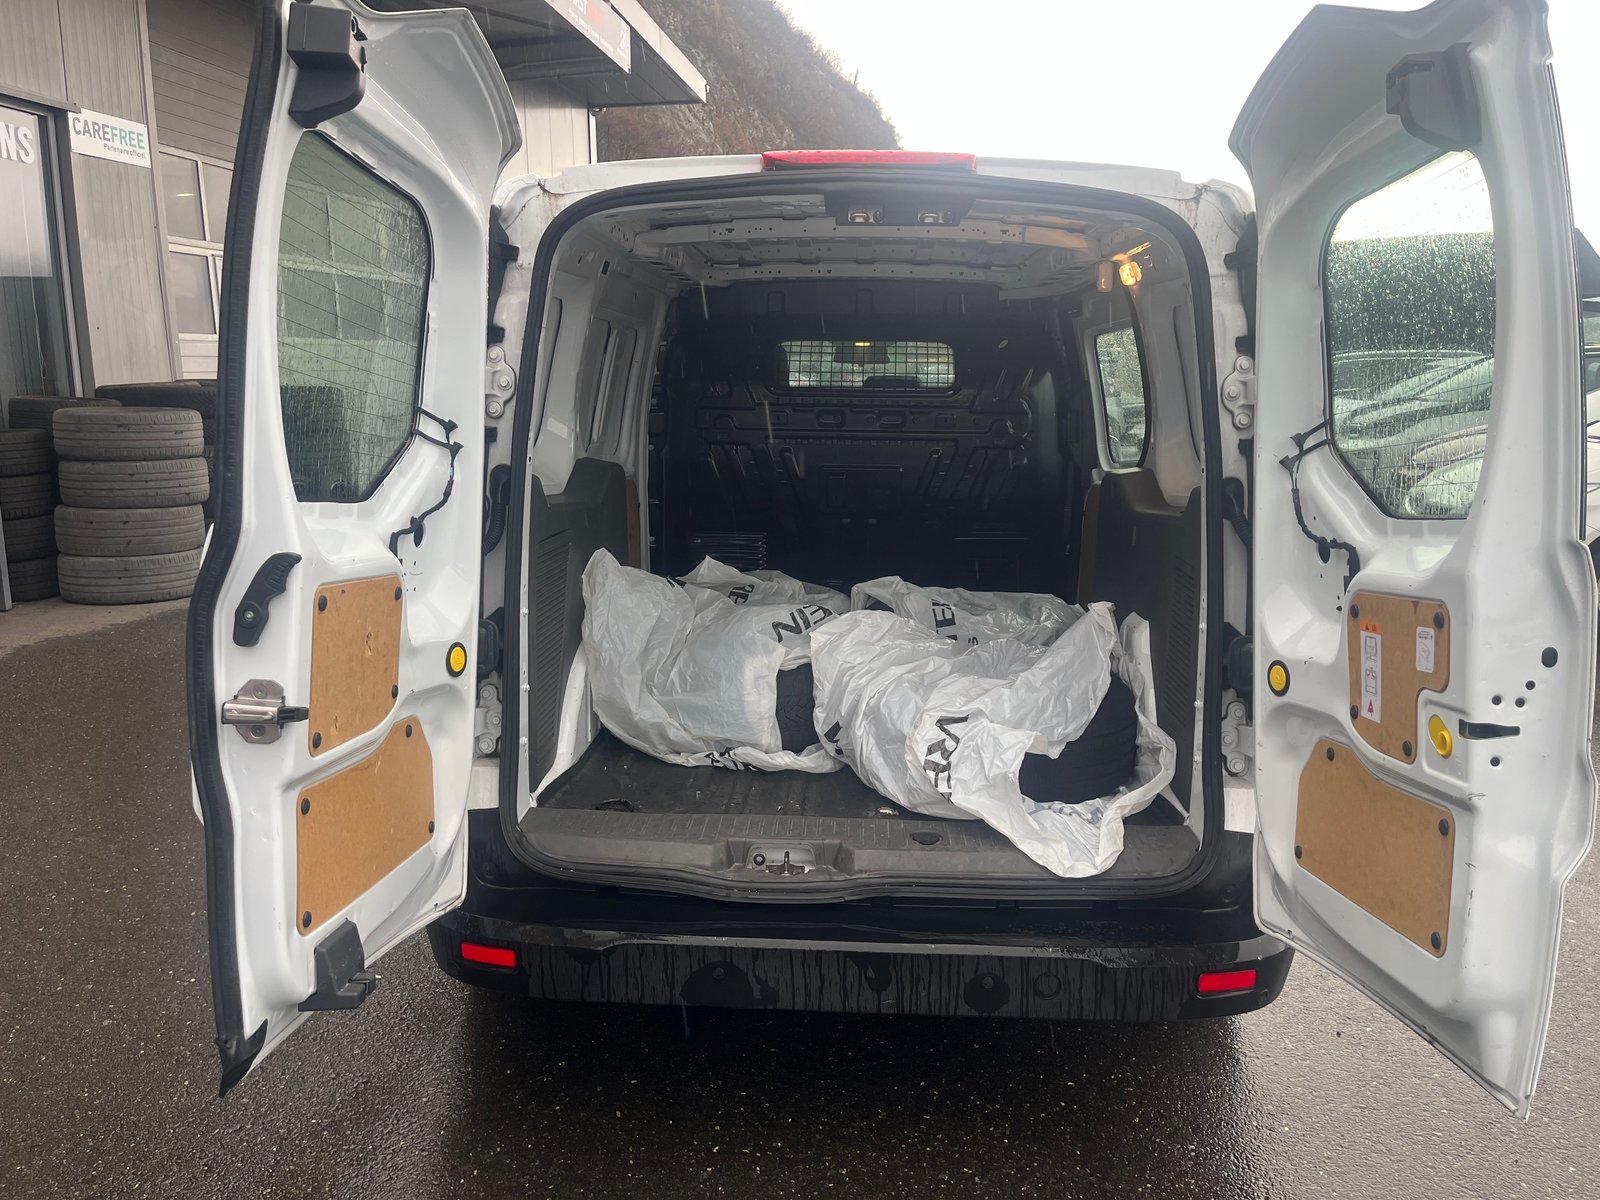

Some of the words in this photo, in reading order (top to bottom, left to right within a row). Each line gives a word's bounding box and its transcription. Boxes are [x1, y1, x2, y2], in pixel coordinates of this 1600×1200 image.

[0, 122, 35, 164] NS
[72, 116, 145, 150] CAREFREE
[103, 143, 129, 155] Partenaire
[130, 149, 146, 159] officiel
